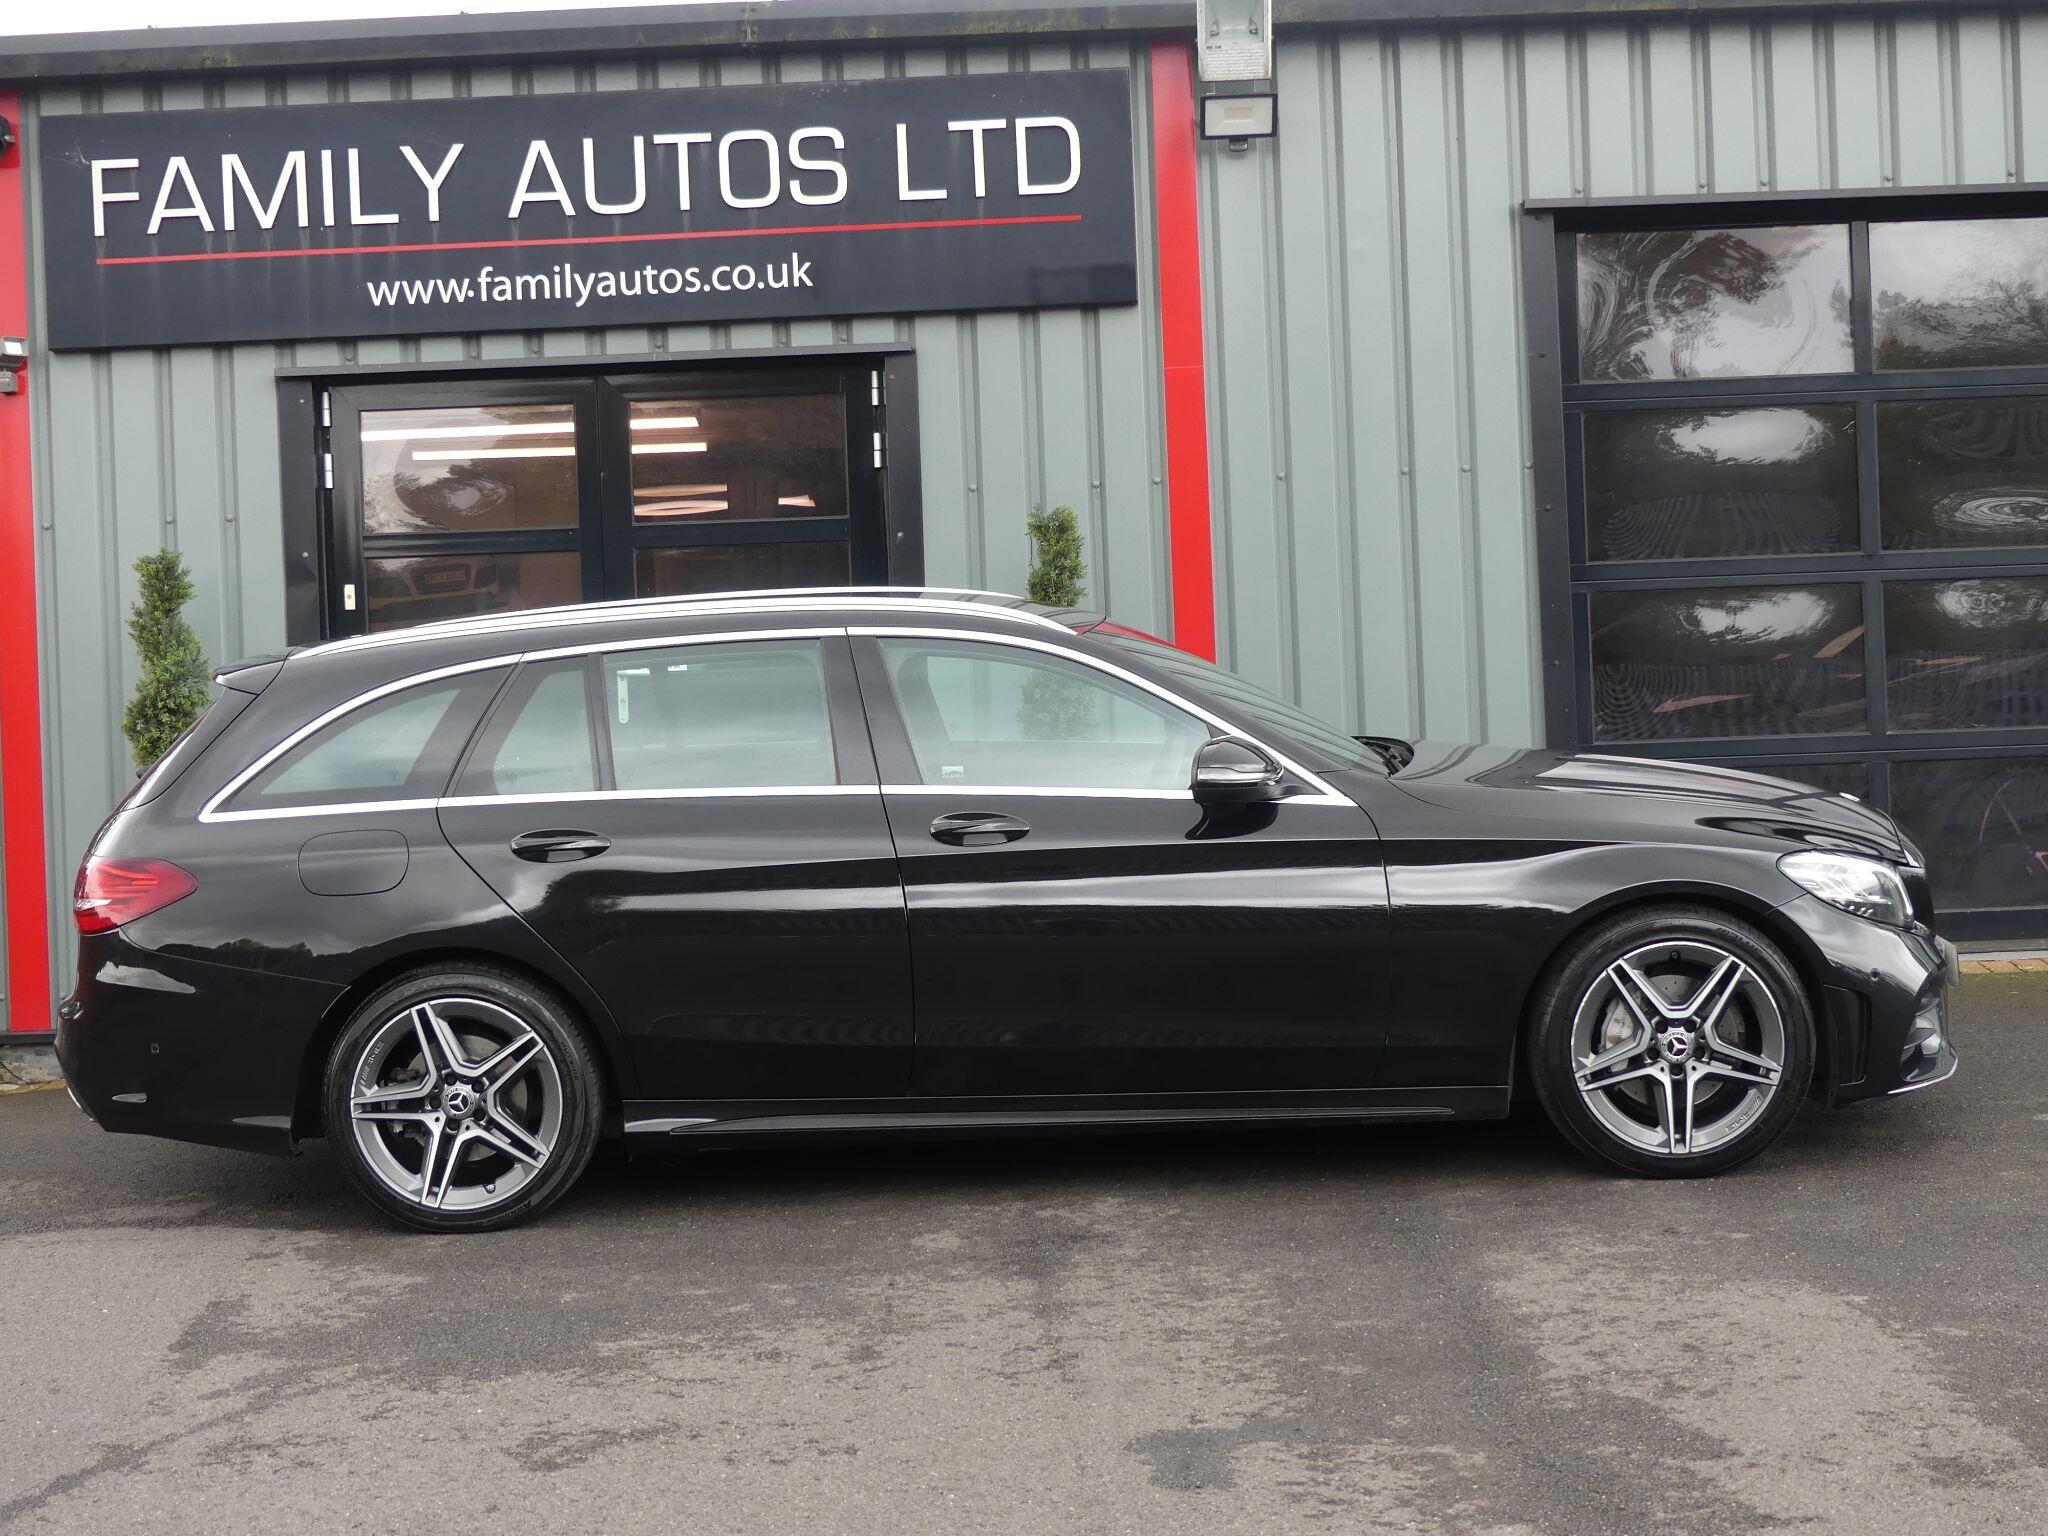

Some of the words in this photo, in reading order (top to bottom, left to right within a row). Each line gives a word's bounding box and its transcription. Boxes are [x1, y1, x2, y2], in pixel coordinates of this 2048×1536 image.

[90, 143, 466, 237] FAMILY
[507, 126, 849, 219] AUTOS
[895, 116, 1082, 201] LTD
[366, 251, 814, 308] www.familyautos.co.uk
